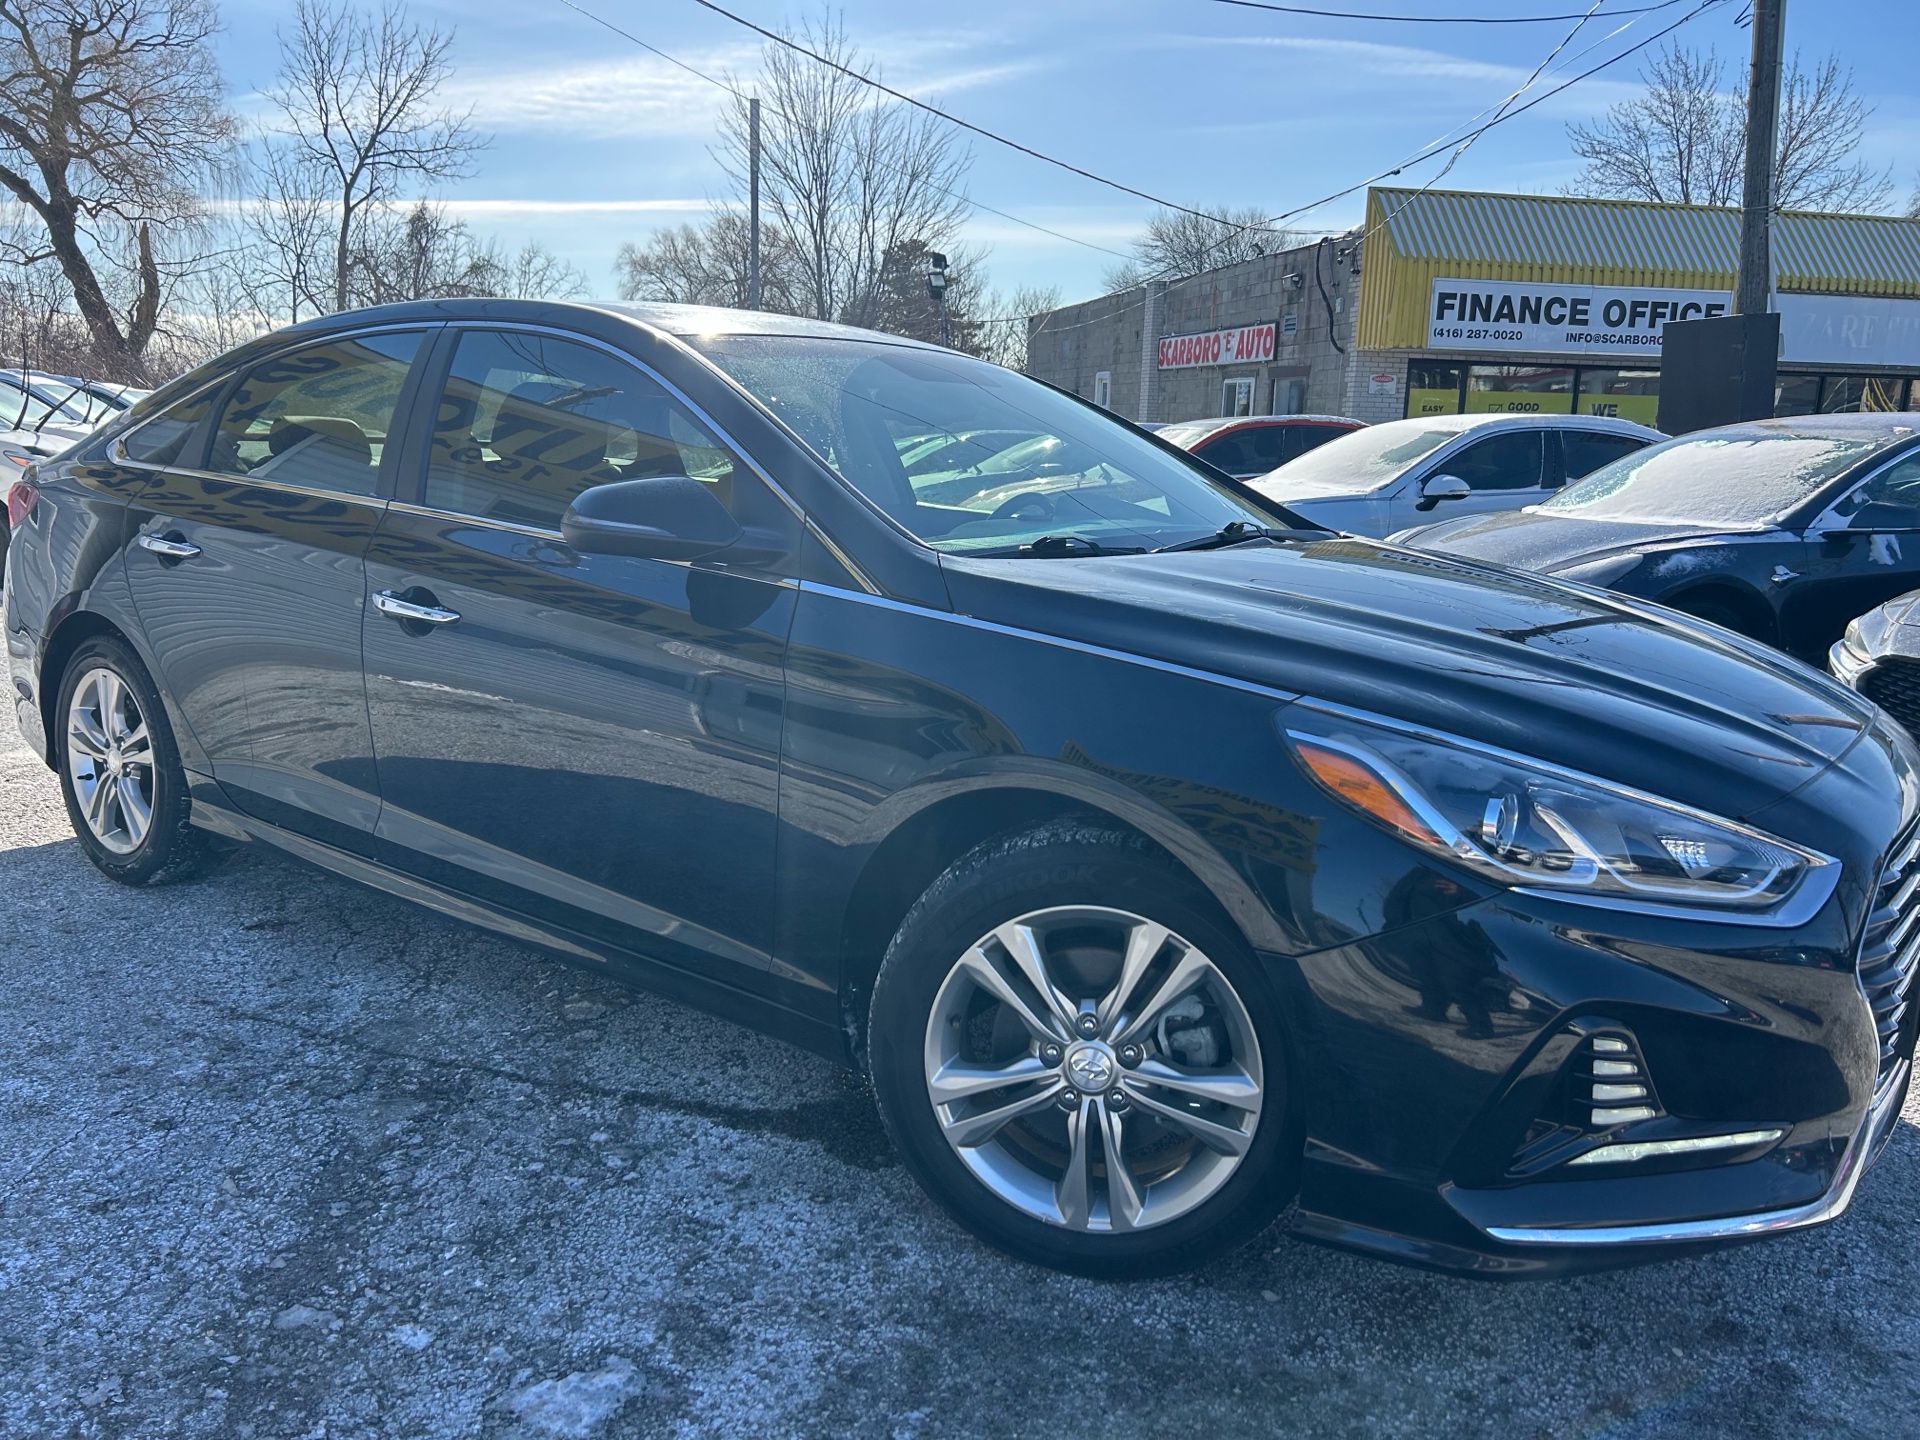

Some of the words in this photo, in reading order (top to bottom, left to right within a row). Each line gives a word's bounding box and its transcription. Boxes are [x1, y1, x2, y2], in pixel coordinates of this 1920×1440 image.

[1435, 292, 1591, 327] FINANCE
[1433, 328, 1463, 339] (416)
[1466, 328, 1523, 341] 287-0020
[1158, 333, 1221, 367] SCARBORO
[1234, 326, 1274, 360] AUTO
[1507, 401, 1540, 412] GOOD
[1591, 403, 1618, 417] WE
